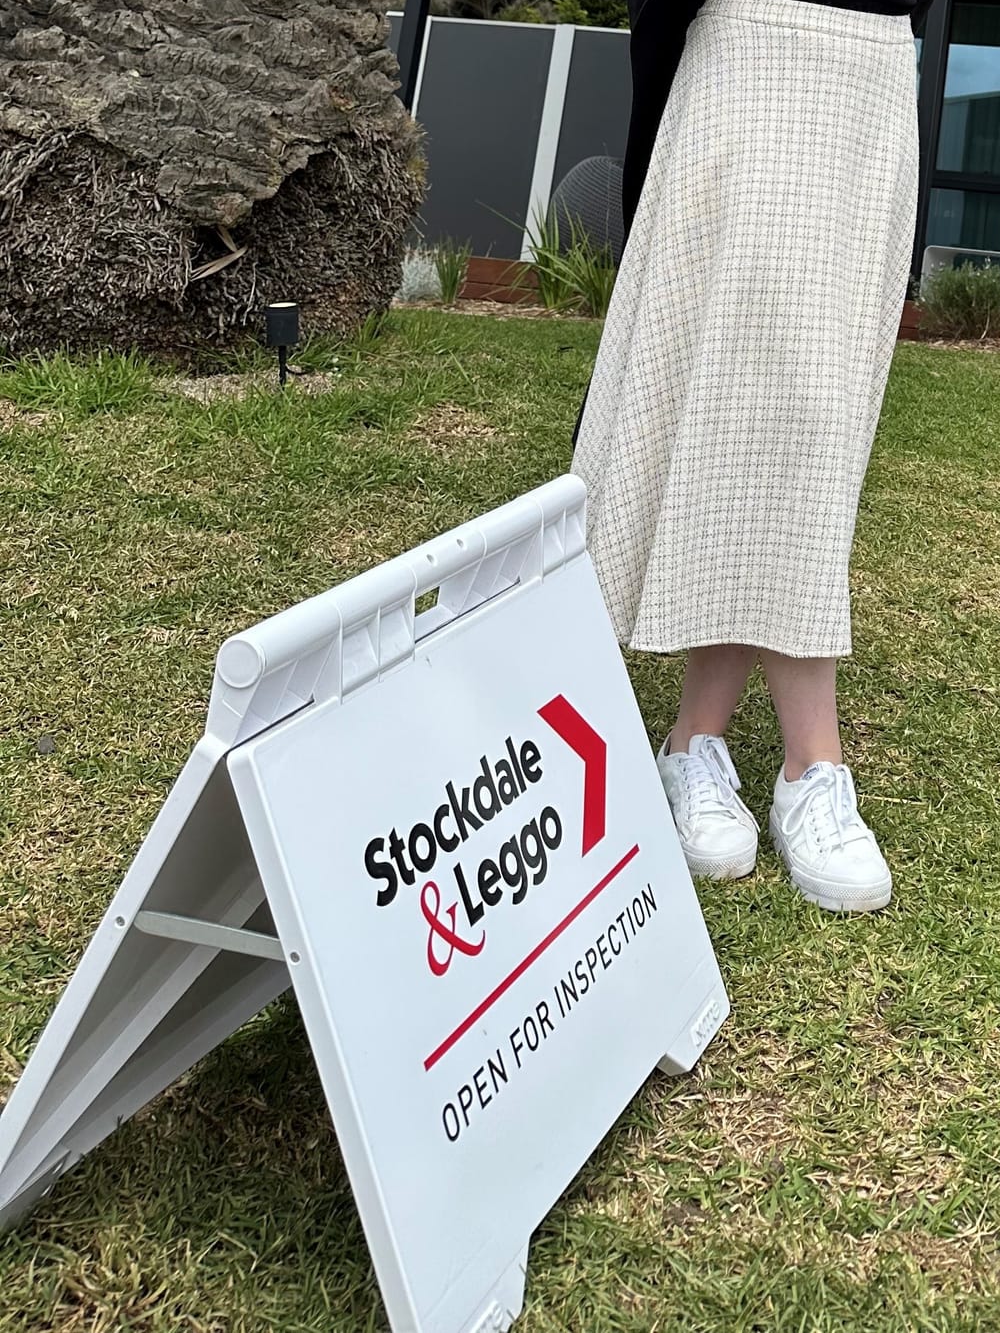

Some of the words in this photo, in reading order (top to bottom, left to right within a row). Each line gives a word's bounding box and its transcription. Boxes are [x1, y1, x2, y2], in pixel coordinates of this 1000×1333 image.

[364, 736, 542, 907] Stockdale
[453, 805, 563, 928] Leggo
[442, 1048, 509, 1143] OPEN
[509, 1000, 555, 1069] FOR
[553, 883, 658, 1019] INSPECTION
